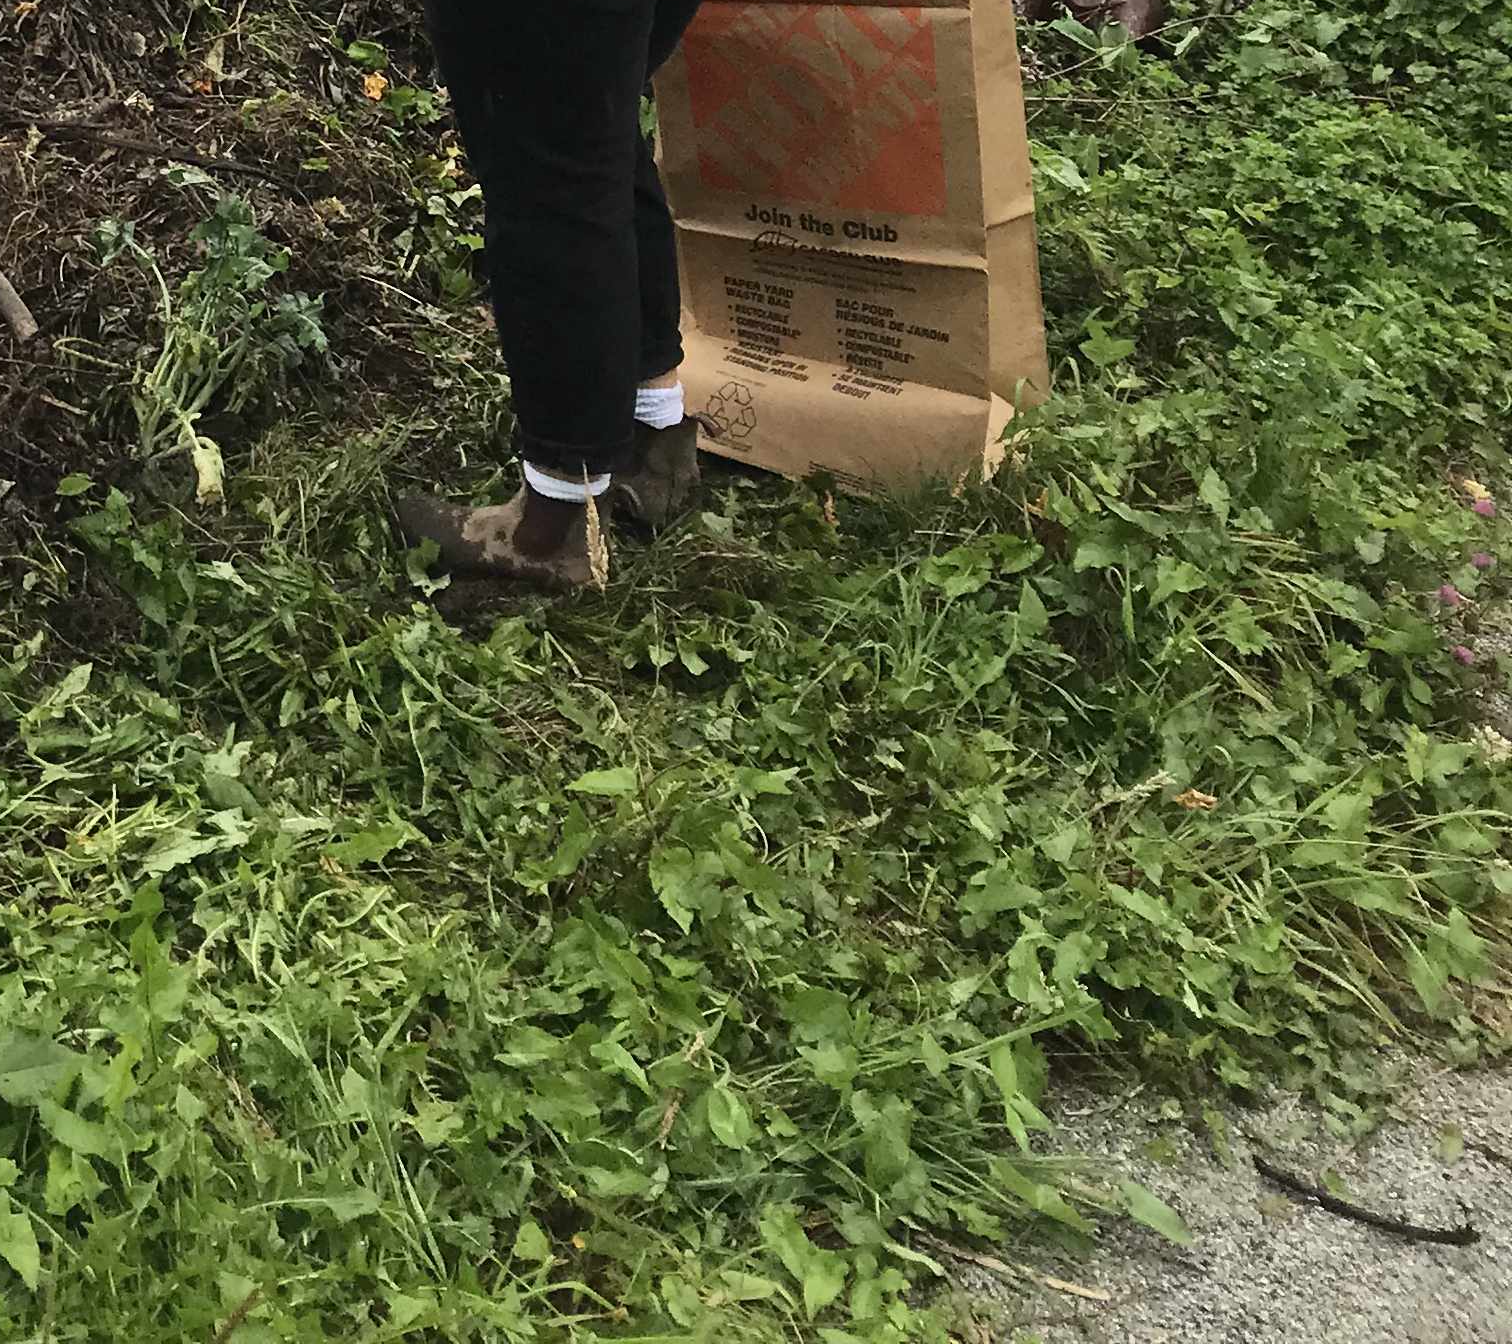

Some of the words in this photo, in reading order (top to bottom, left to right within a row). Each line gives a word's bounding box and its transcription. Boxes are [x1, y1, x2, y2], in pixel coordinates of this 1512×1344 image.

[745, 204, 792, 228] Join
[799, 213, 834, 236] the
[842, 220, 899, 243] Club
[726, 287, 765, 304] WASTE
[767, 295, 791, 309] BAG
[764, 283, 793, 299] YARD
[862, 303, 894, 318] POUR
[889, 321, 904, 332] DE
[906, 325, 950, 343] JARDIN
